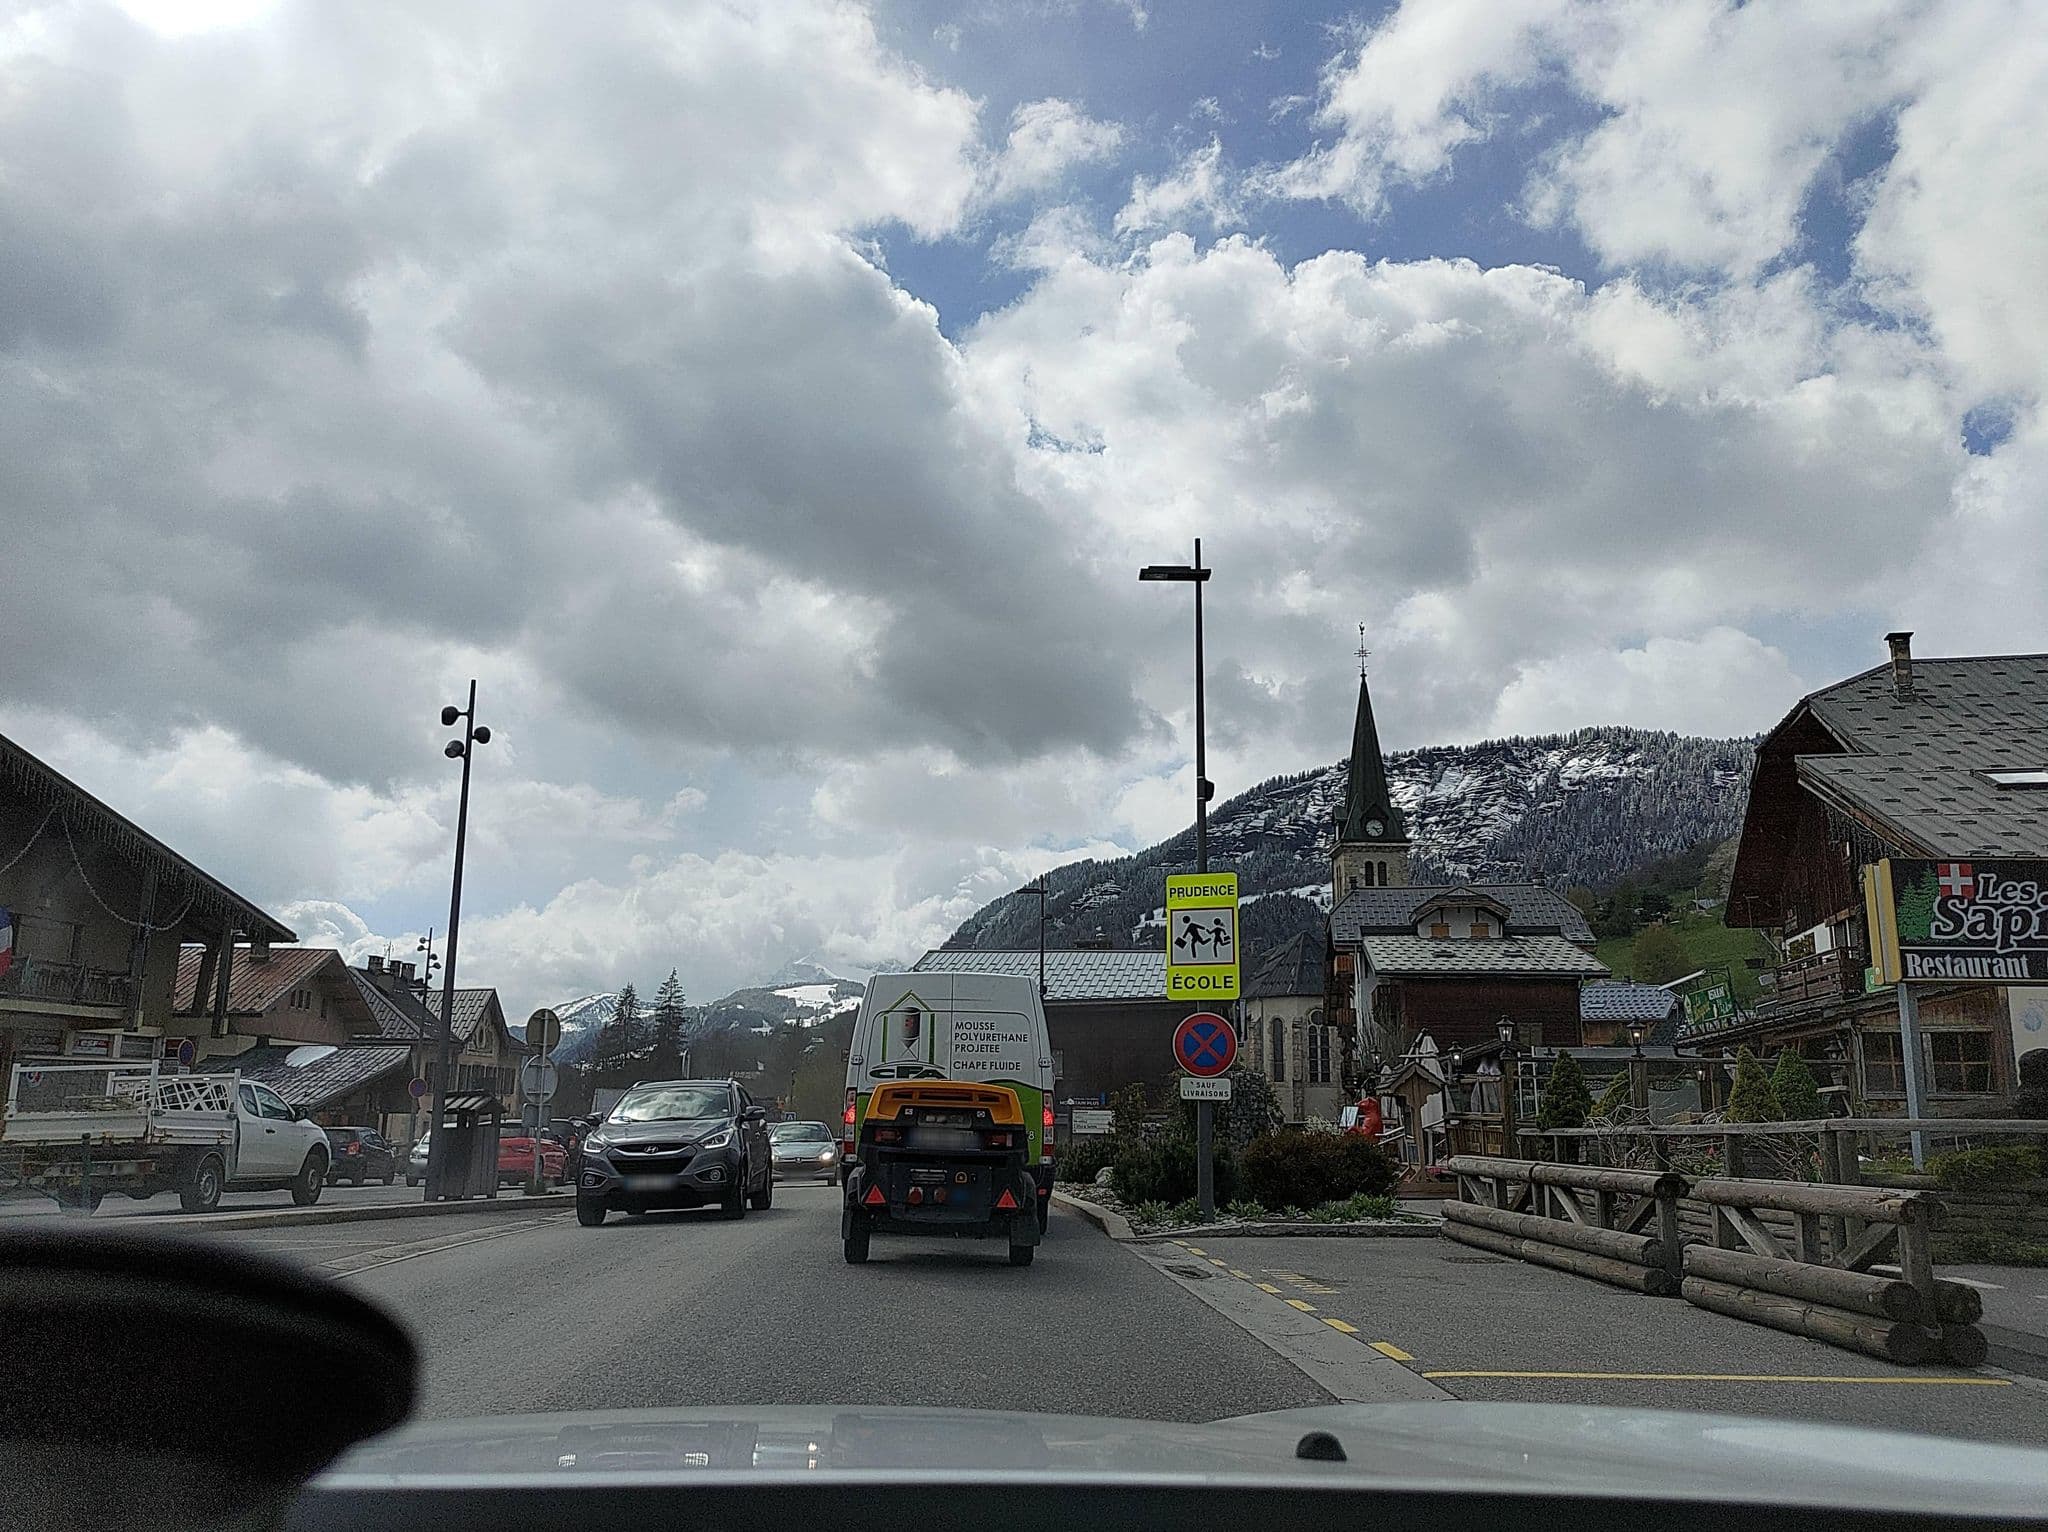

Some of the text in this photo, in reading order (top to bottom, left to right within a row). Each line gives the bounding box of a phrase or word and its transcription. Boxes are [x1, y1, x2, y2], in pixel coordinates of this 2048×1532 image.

[1169, 883, 1235, 898] PRUDENCE
[1976, 873, 2038, 905] Les
[1904, 953, 2031, 978] Restaurant
[1172, 972, 1235, 990] ÉCOLE
[954, 1021, 996, 1031] MOUSSE
[954, 1032, 1028, 1043] POLYURETHANE
[954, 1044, 1000, 1054] PROJETEE
[953, 1060, 1021, 1072] CHAPE FLUIDE
[1195, 1081, 1217, 1089] SAUF
[1182, 1089, 1230, 1099] LIVRAISONS
